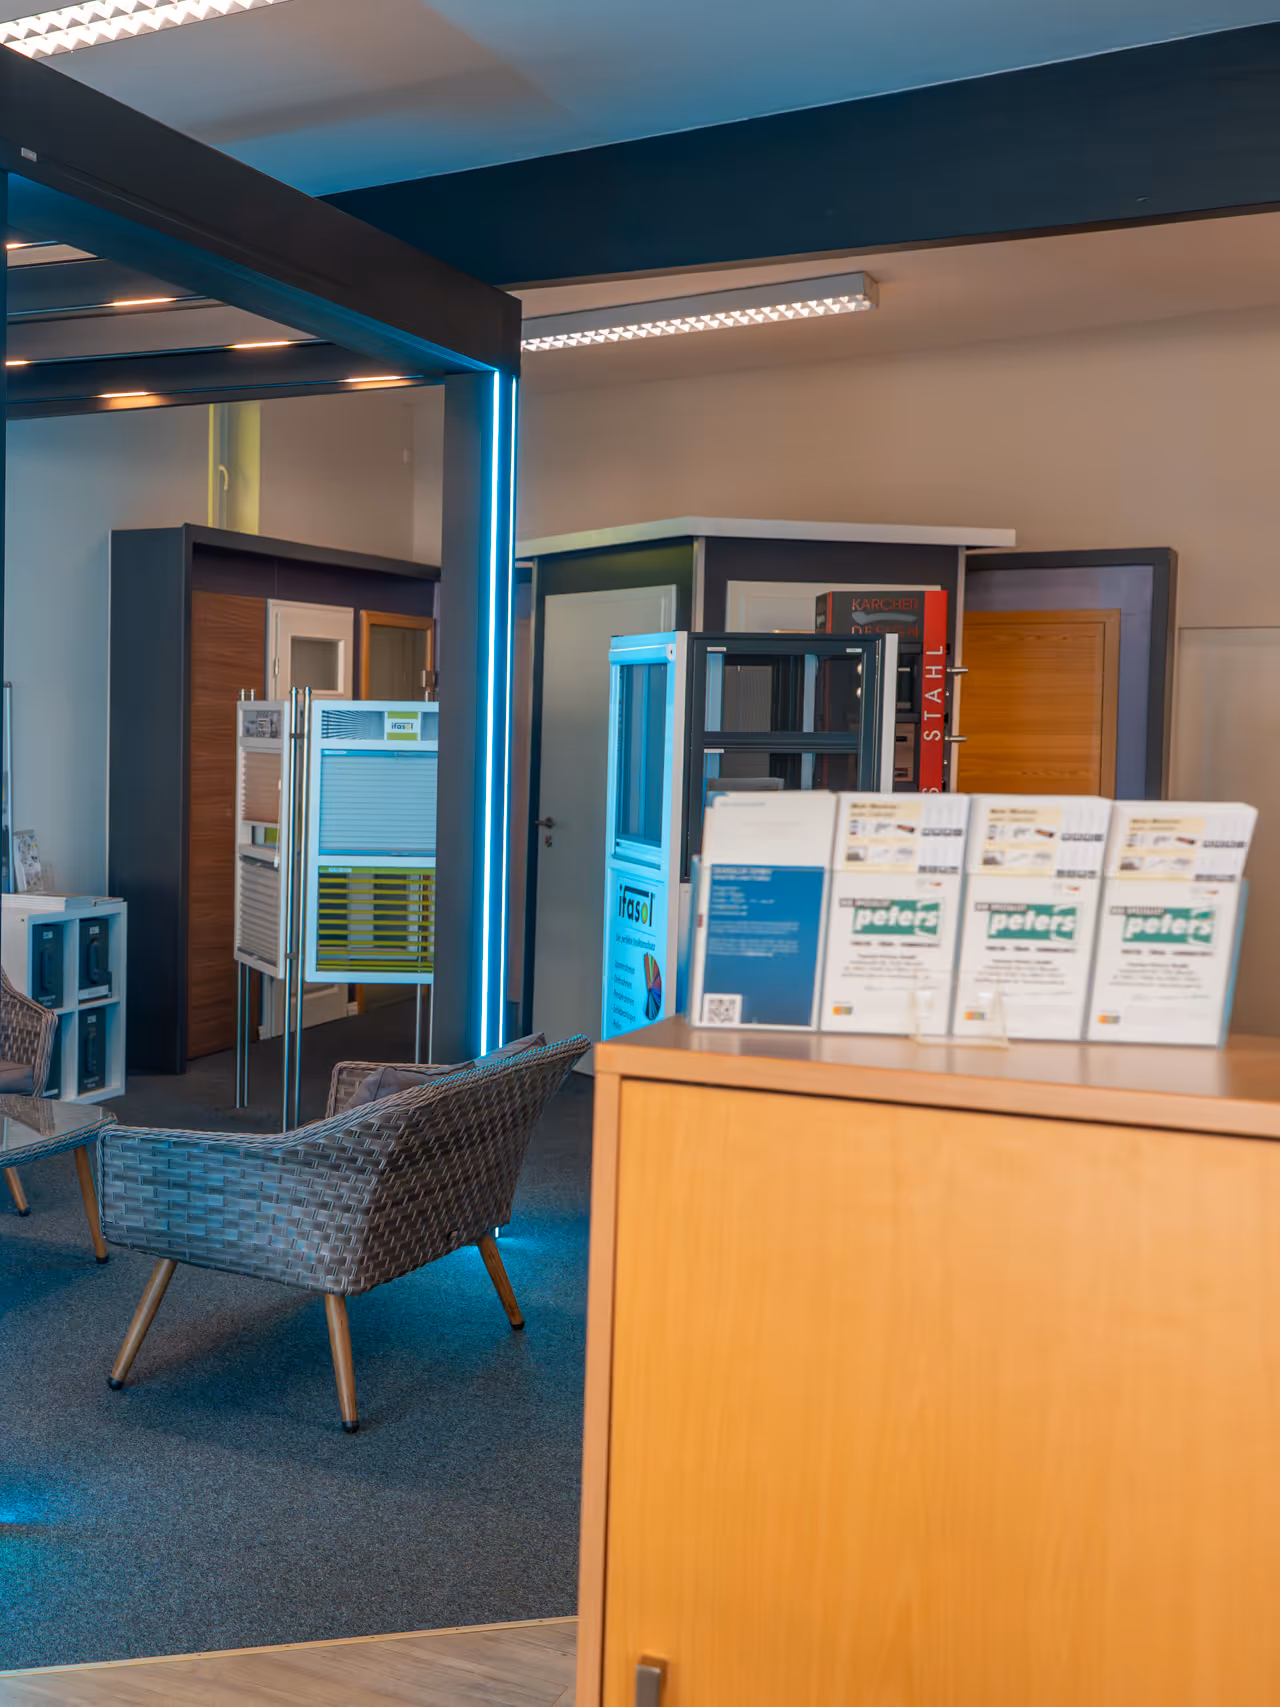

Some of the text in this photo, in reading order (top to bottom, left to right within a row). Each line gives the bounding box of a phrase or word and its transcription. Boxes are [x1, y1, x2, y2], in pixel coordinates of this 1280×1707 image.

[923, 646, 943, 741] STAHL
[391, 722, 414, 730] ifasol
[618, 884, 654, 927] ifasol
[854, 906, 937, 931] peters
[990, 910, 1074, 935] peters
[1125, 914, 1211, 939] peters
